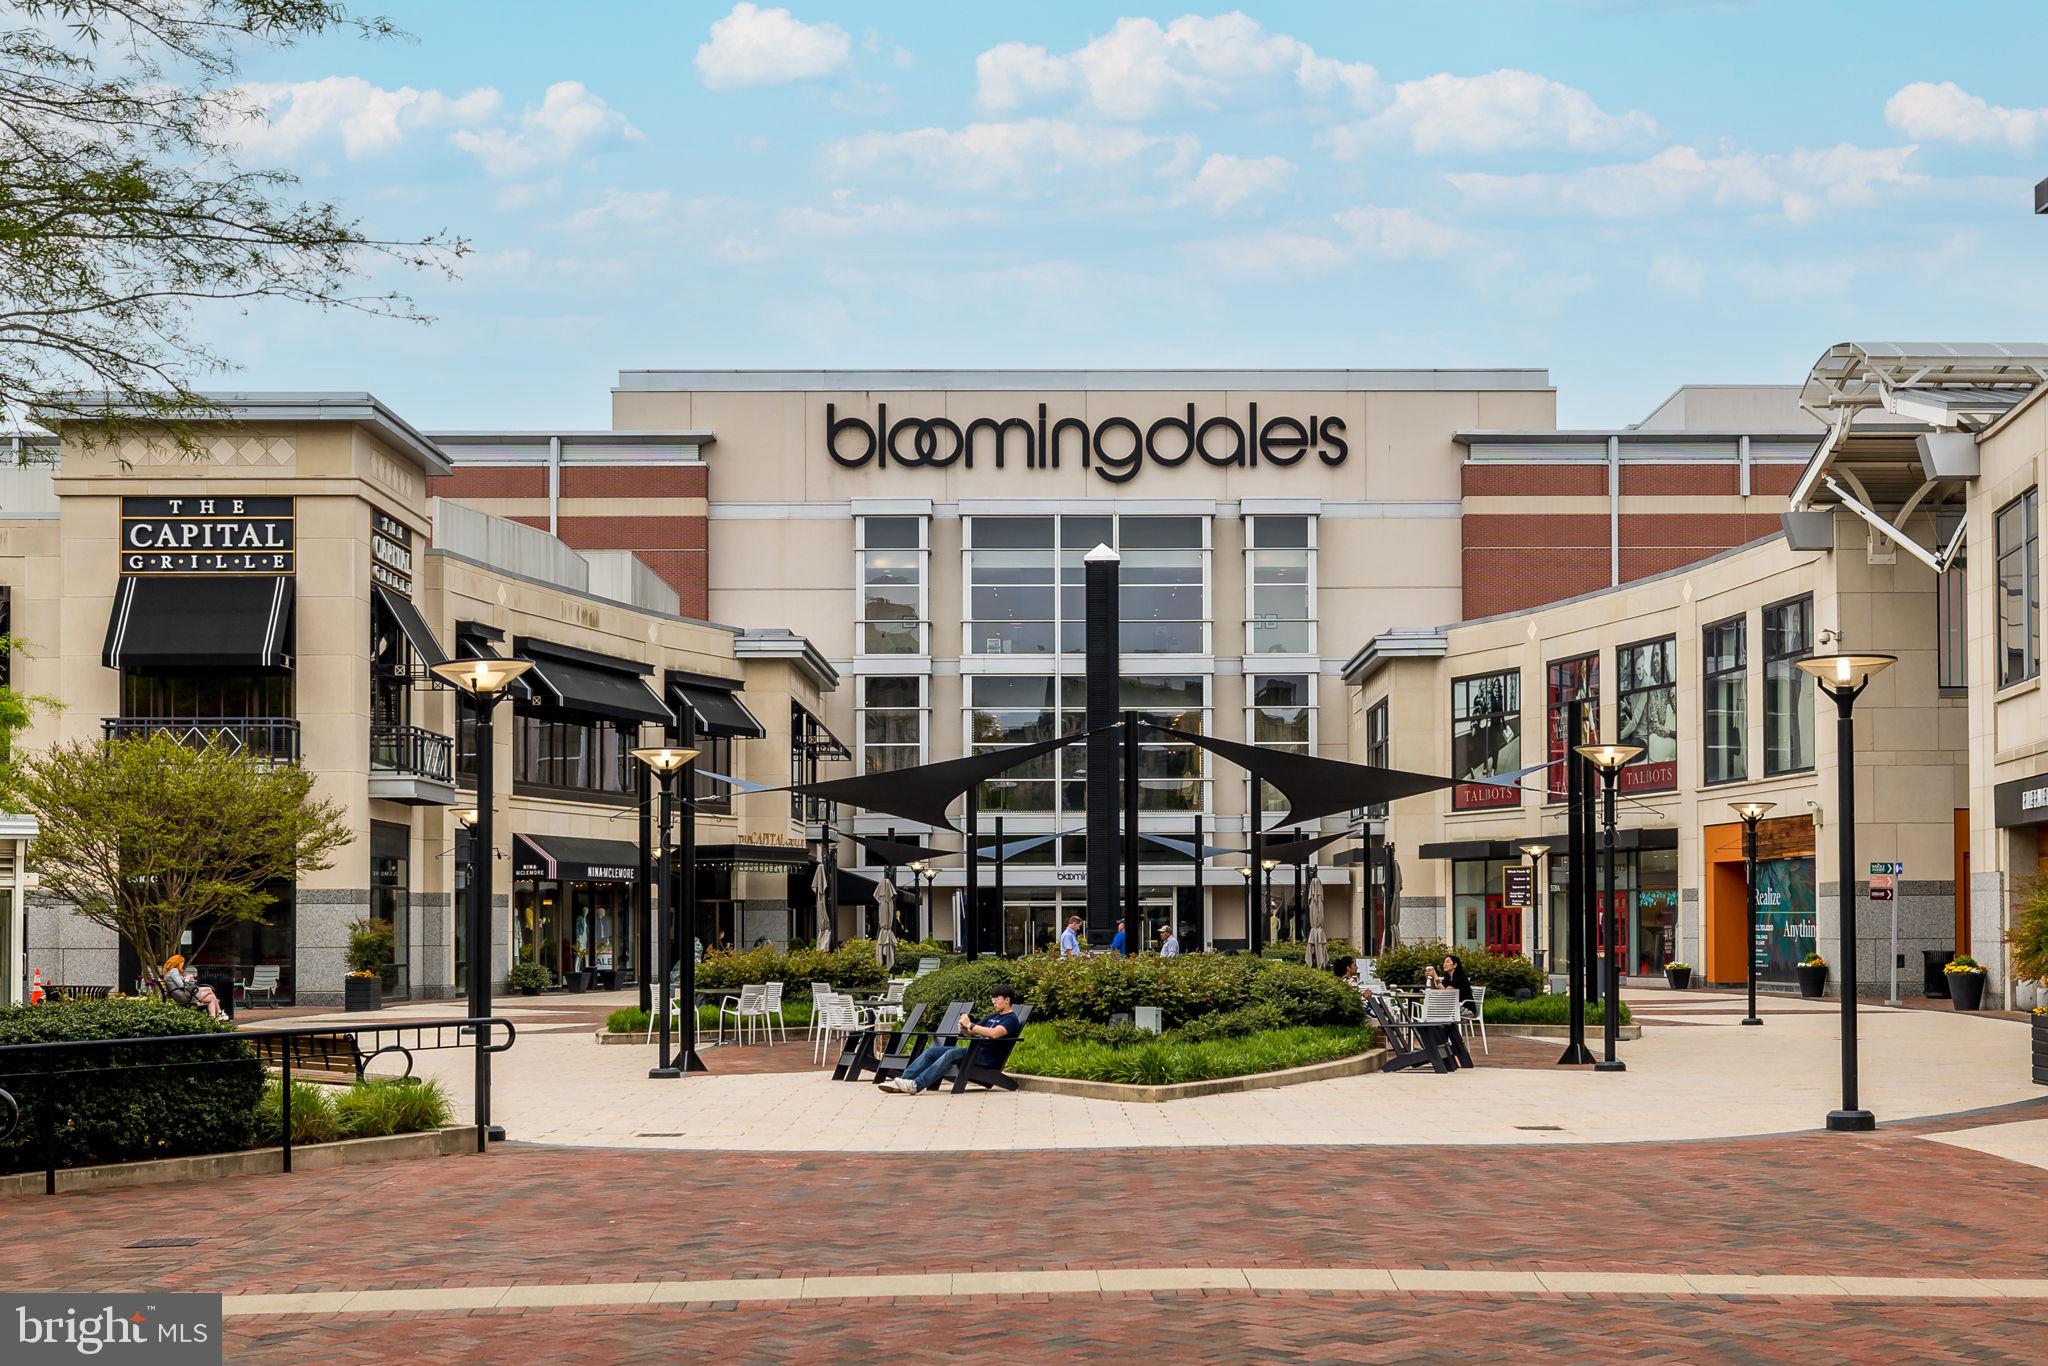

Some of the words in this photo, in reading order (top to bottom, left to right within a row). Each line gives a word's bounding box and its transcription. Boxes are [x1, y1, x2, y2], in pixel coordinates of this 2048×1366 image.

[826, 402, 1349, 483] bloomingdale's
[169, 500, 245, 514] THE
[130, 523, 284, 548] CAPITAL
[1626, 767, 1673, 785] TALBOTS
[1464, 786, 1513, 802] TALBOTS
[1783, 919, 1816, 943] Anythin
